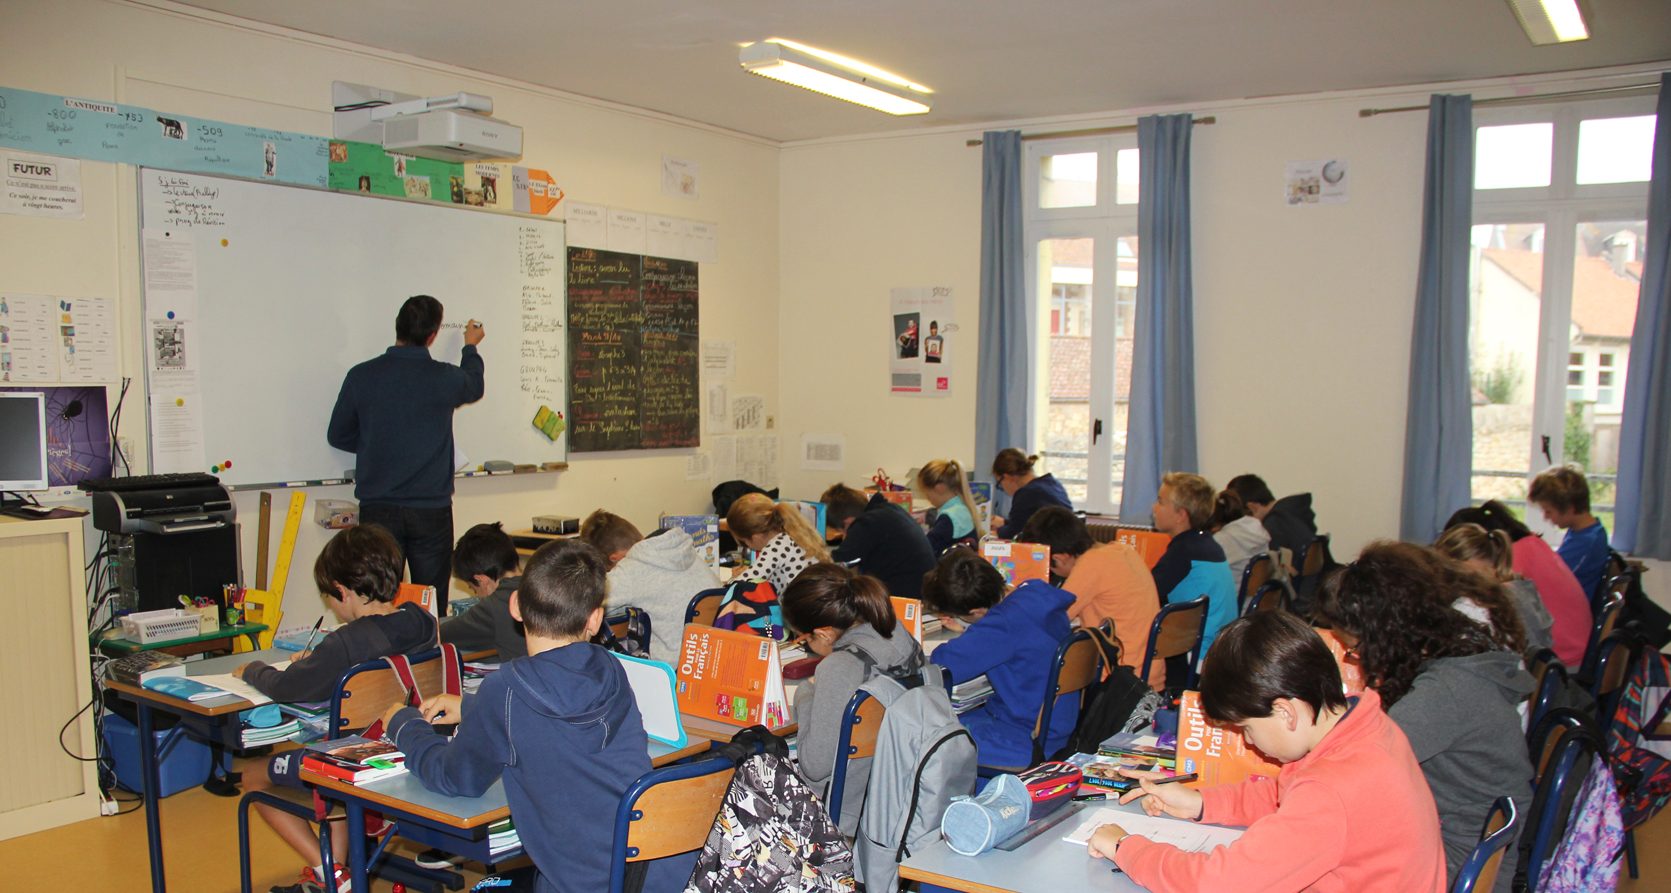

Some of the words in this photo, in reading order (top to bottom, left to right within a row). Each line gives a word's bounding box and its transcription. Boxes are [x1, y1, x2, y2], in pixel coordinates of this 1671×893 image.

[65, 99, 115, 113] L'ANTIQUITE
[13, 163, 52, 176] FUTUR
[681, 633, 698, 675] Outils
[693, 633, 710, 681] Français
[1206, 728, 1222, 758] Fran
